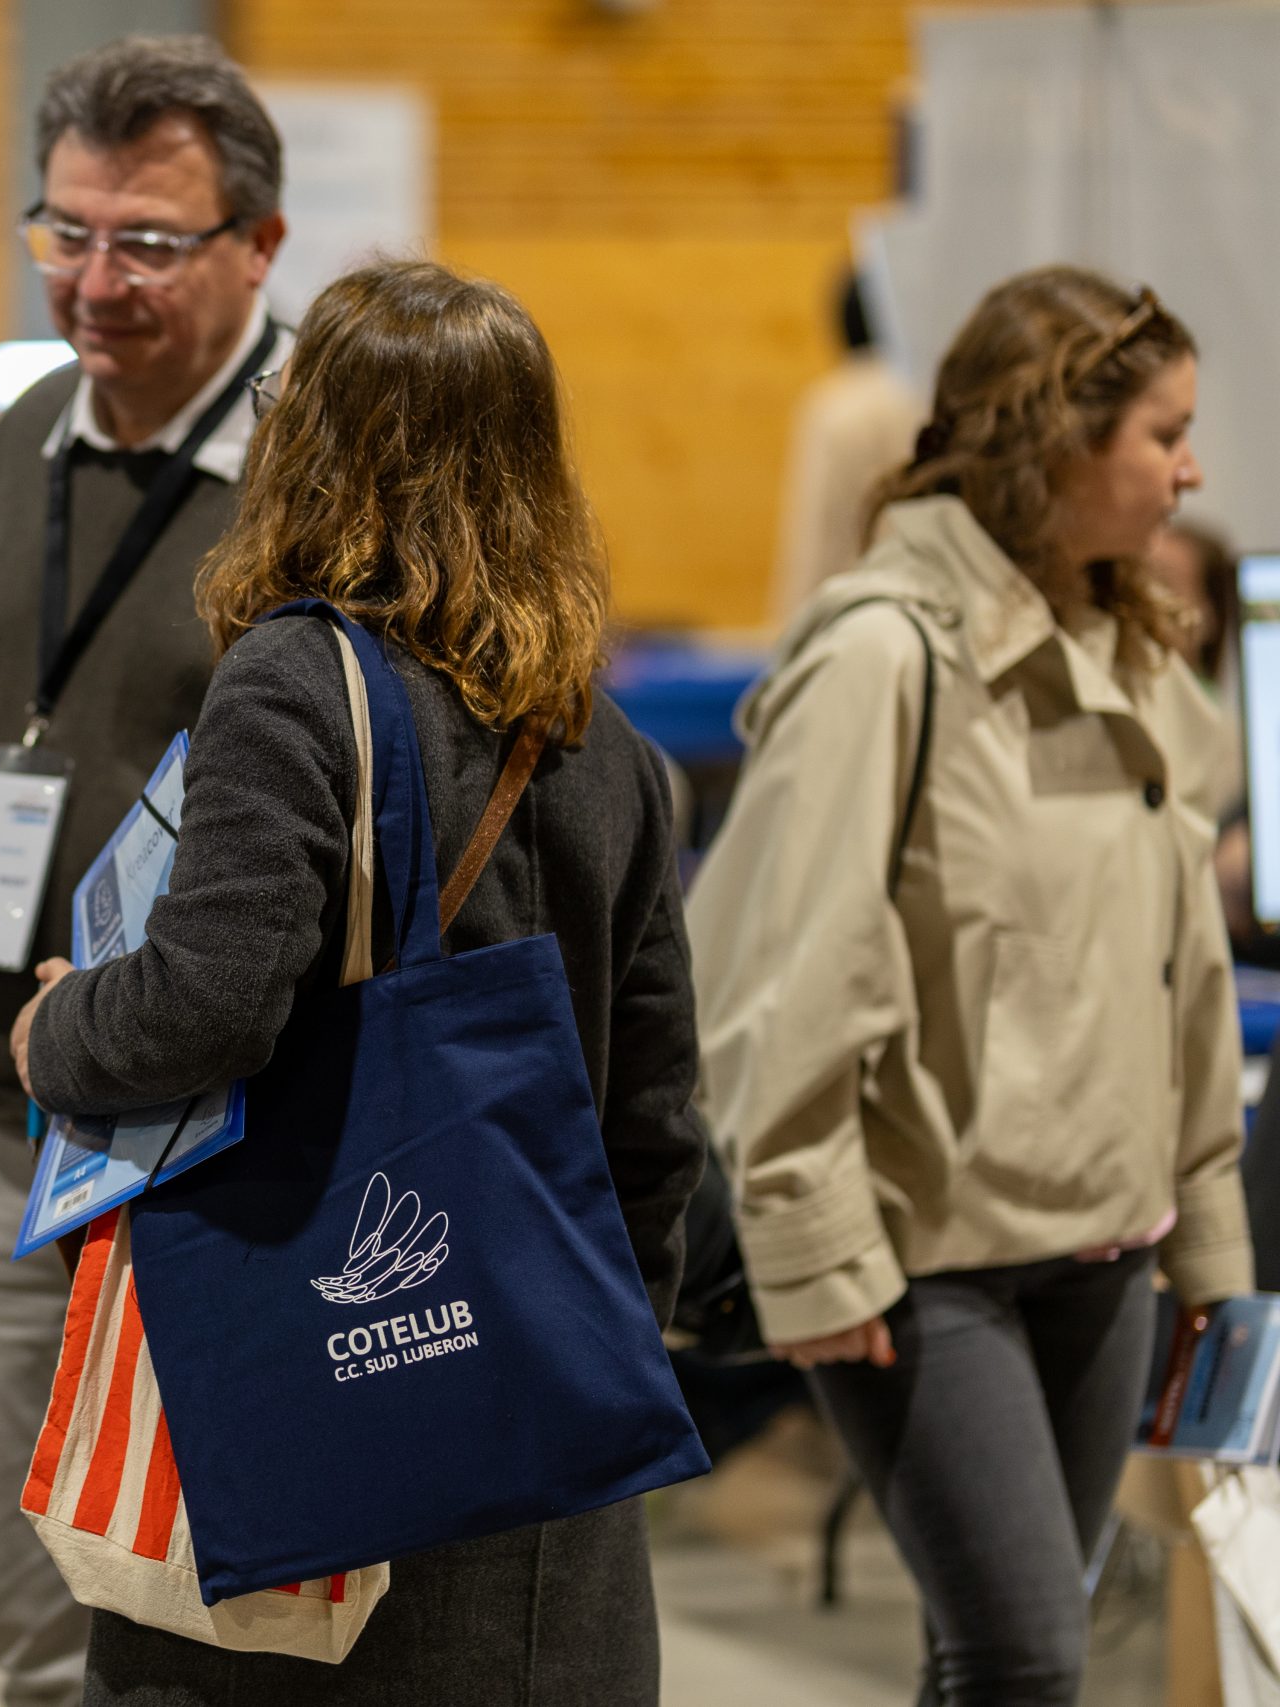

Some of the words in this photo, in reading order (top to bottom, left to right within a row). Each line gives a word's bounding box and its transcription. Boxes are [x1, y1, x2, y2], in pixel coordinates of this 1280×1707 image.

[327, 1300, 473, 1361] COTELUB
[334, 1363, 363, 1382] C.C.
[365, 1353, 398, 1374] SUD
[402, 1332, 478, 1364] LUBERON
